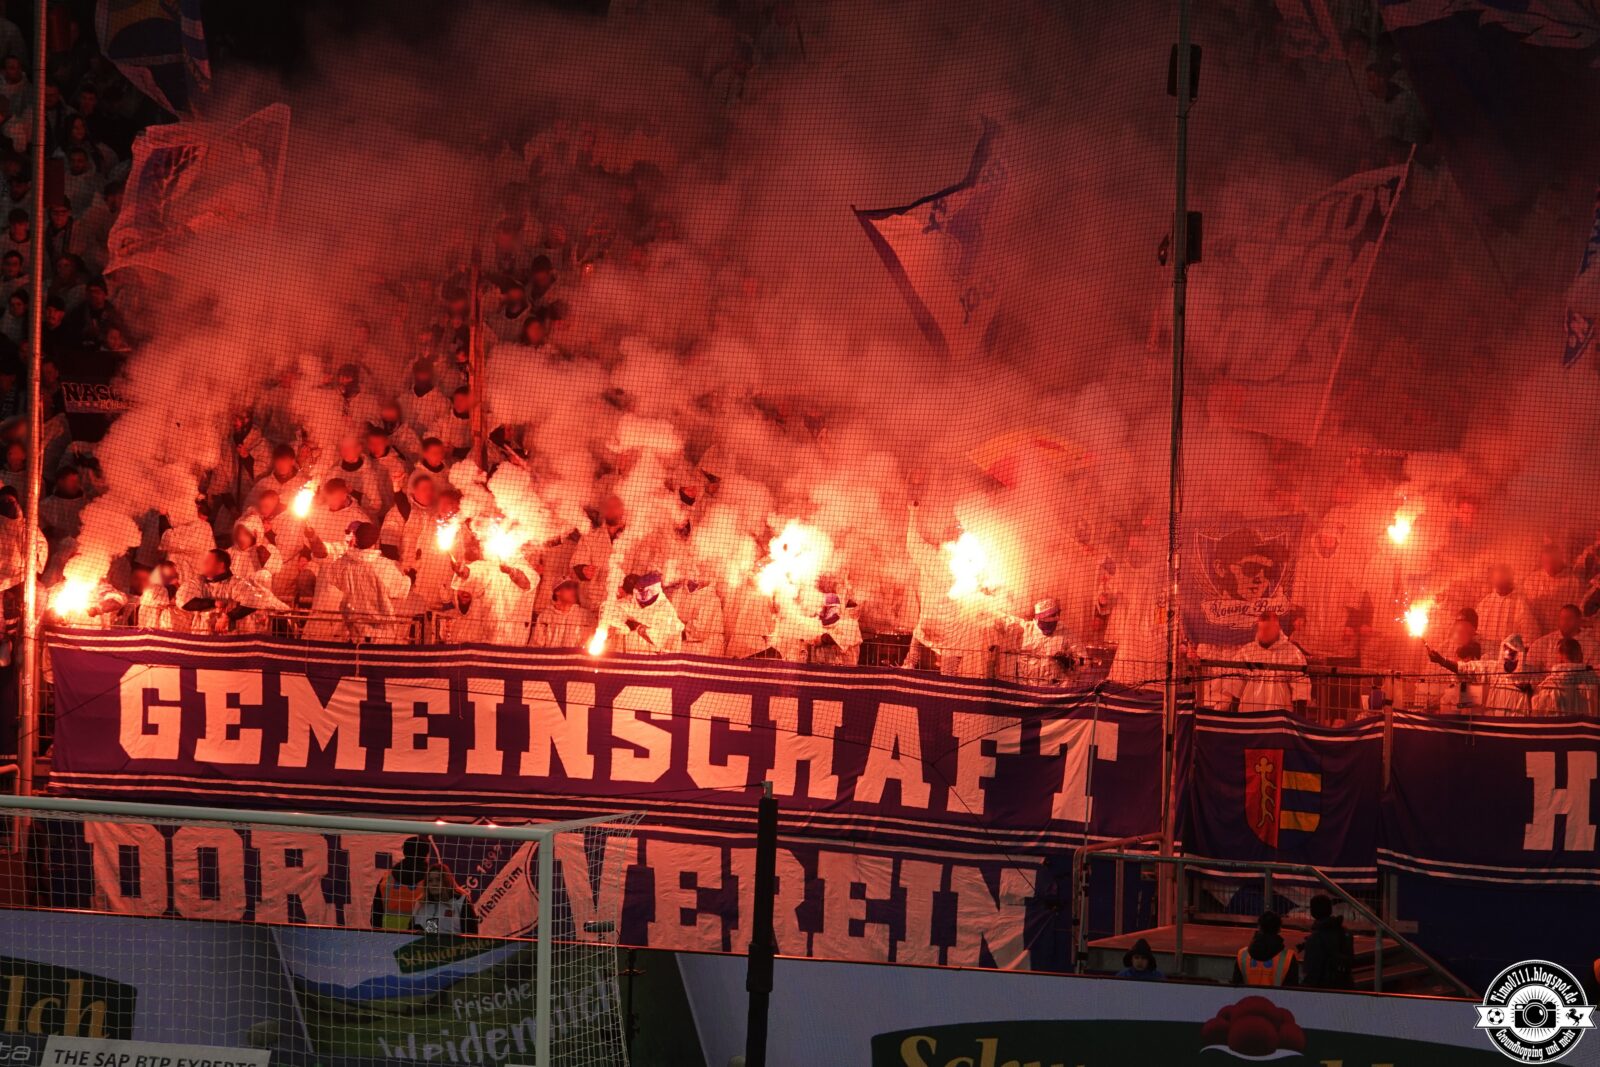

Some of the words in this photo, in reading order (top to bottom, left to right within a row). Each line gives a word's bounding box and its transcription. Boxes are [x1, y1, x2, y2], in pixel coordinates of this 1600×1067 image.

[118, 664, 1119, 823] GEMEINSCHAFT
[1523, 751, 1597, 851] H
[553, 832, 1037, 971] VEREIN
[454, 983, 531, 1019] frische
[54, 1049, 90, 1066] THE
[93, 1052, 130, 1067] SAP
